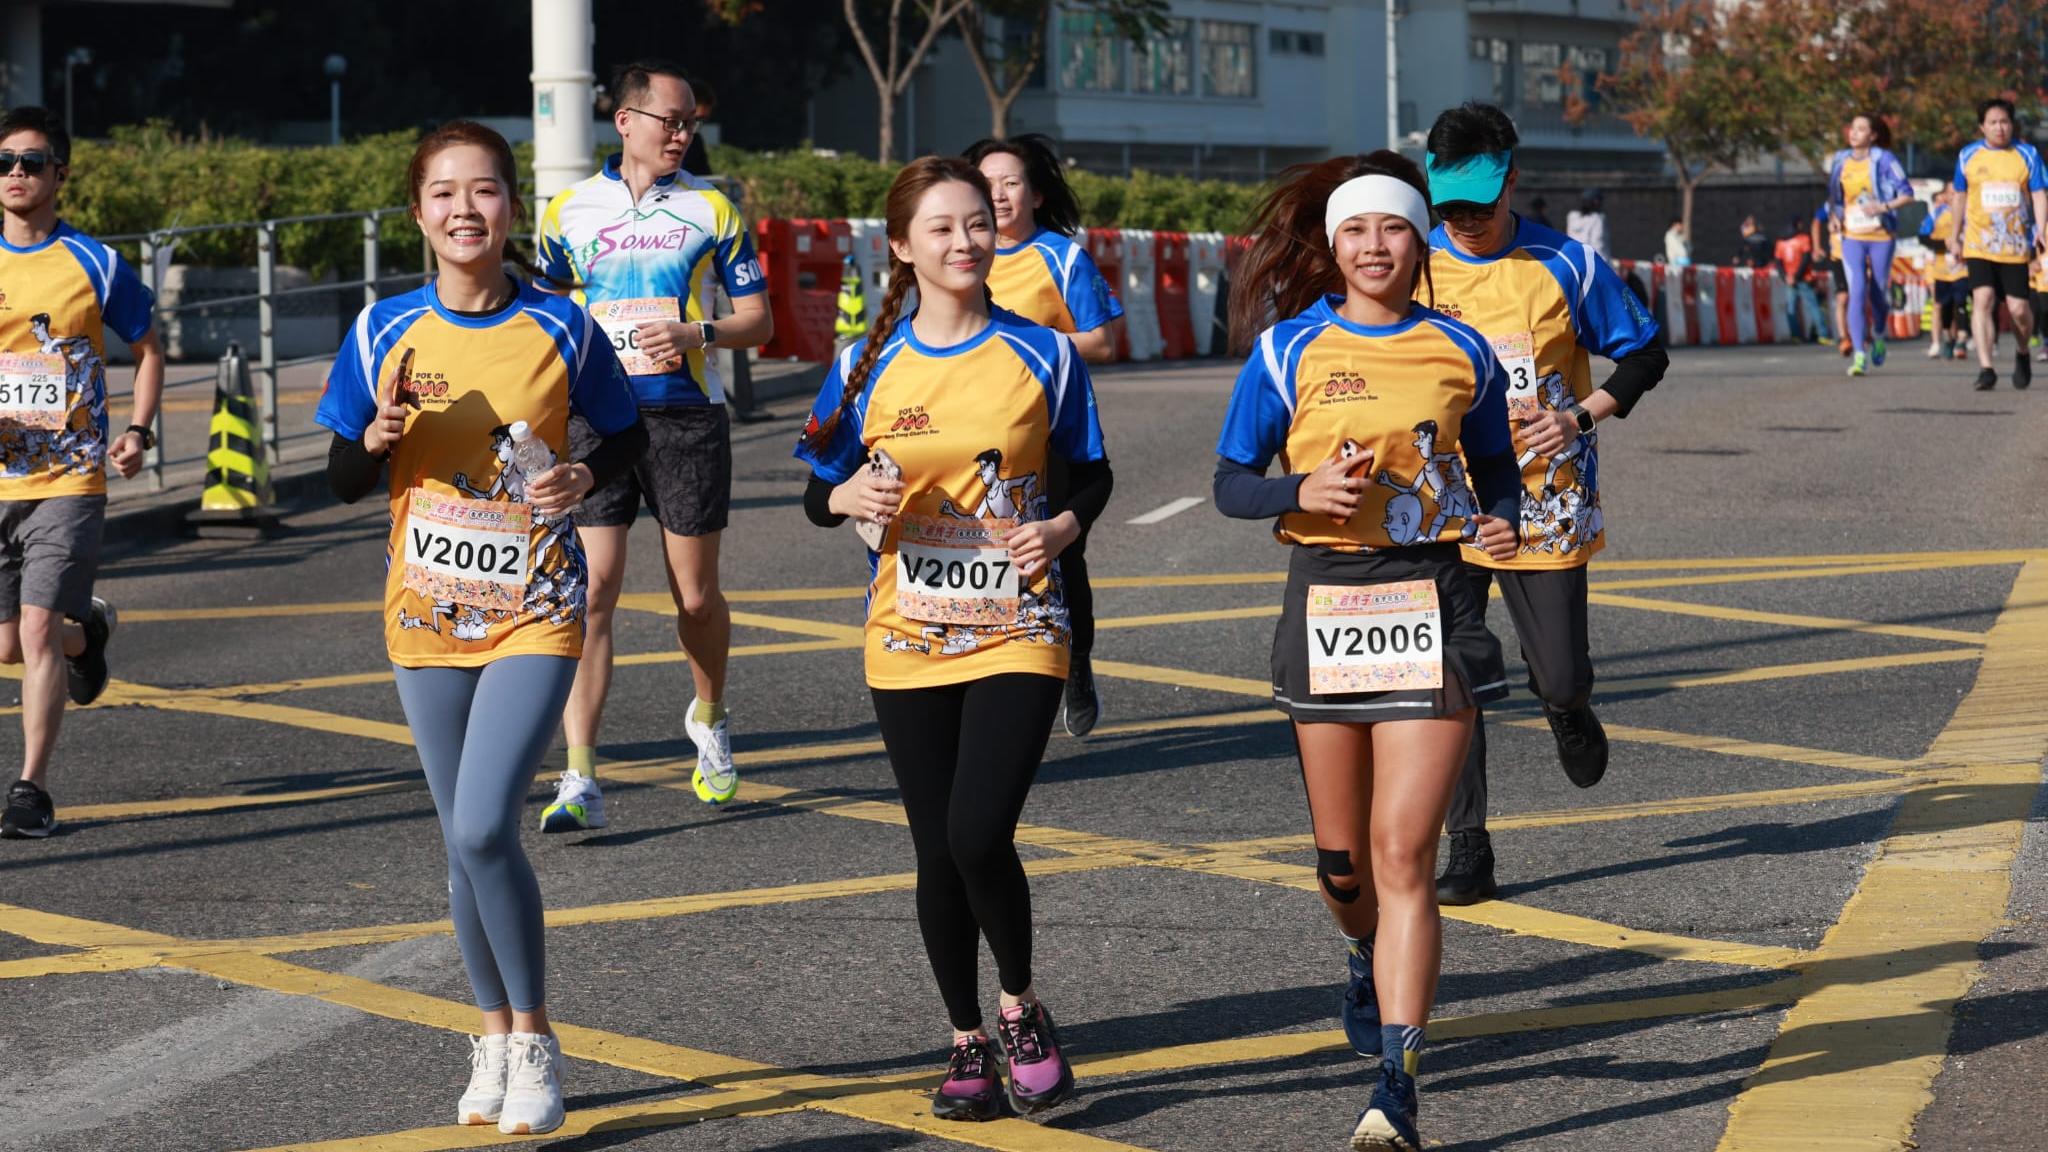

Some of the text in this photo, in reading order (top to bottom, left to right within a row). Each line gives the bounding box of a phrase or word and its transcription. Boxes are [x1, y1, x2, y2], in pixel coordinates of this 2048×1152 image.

[735, 256, 764, 286] SO
[32, 374, 48, 383] 225
[1508, 367, 1529, 390] 3
[413, 527, 520, 576] V2002
[902, 553, 1010, 590] V2007
[1315, 622, 1433, 657] V2006
